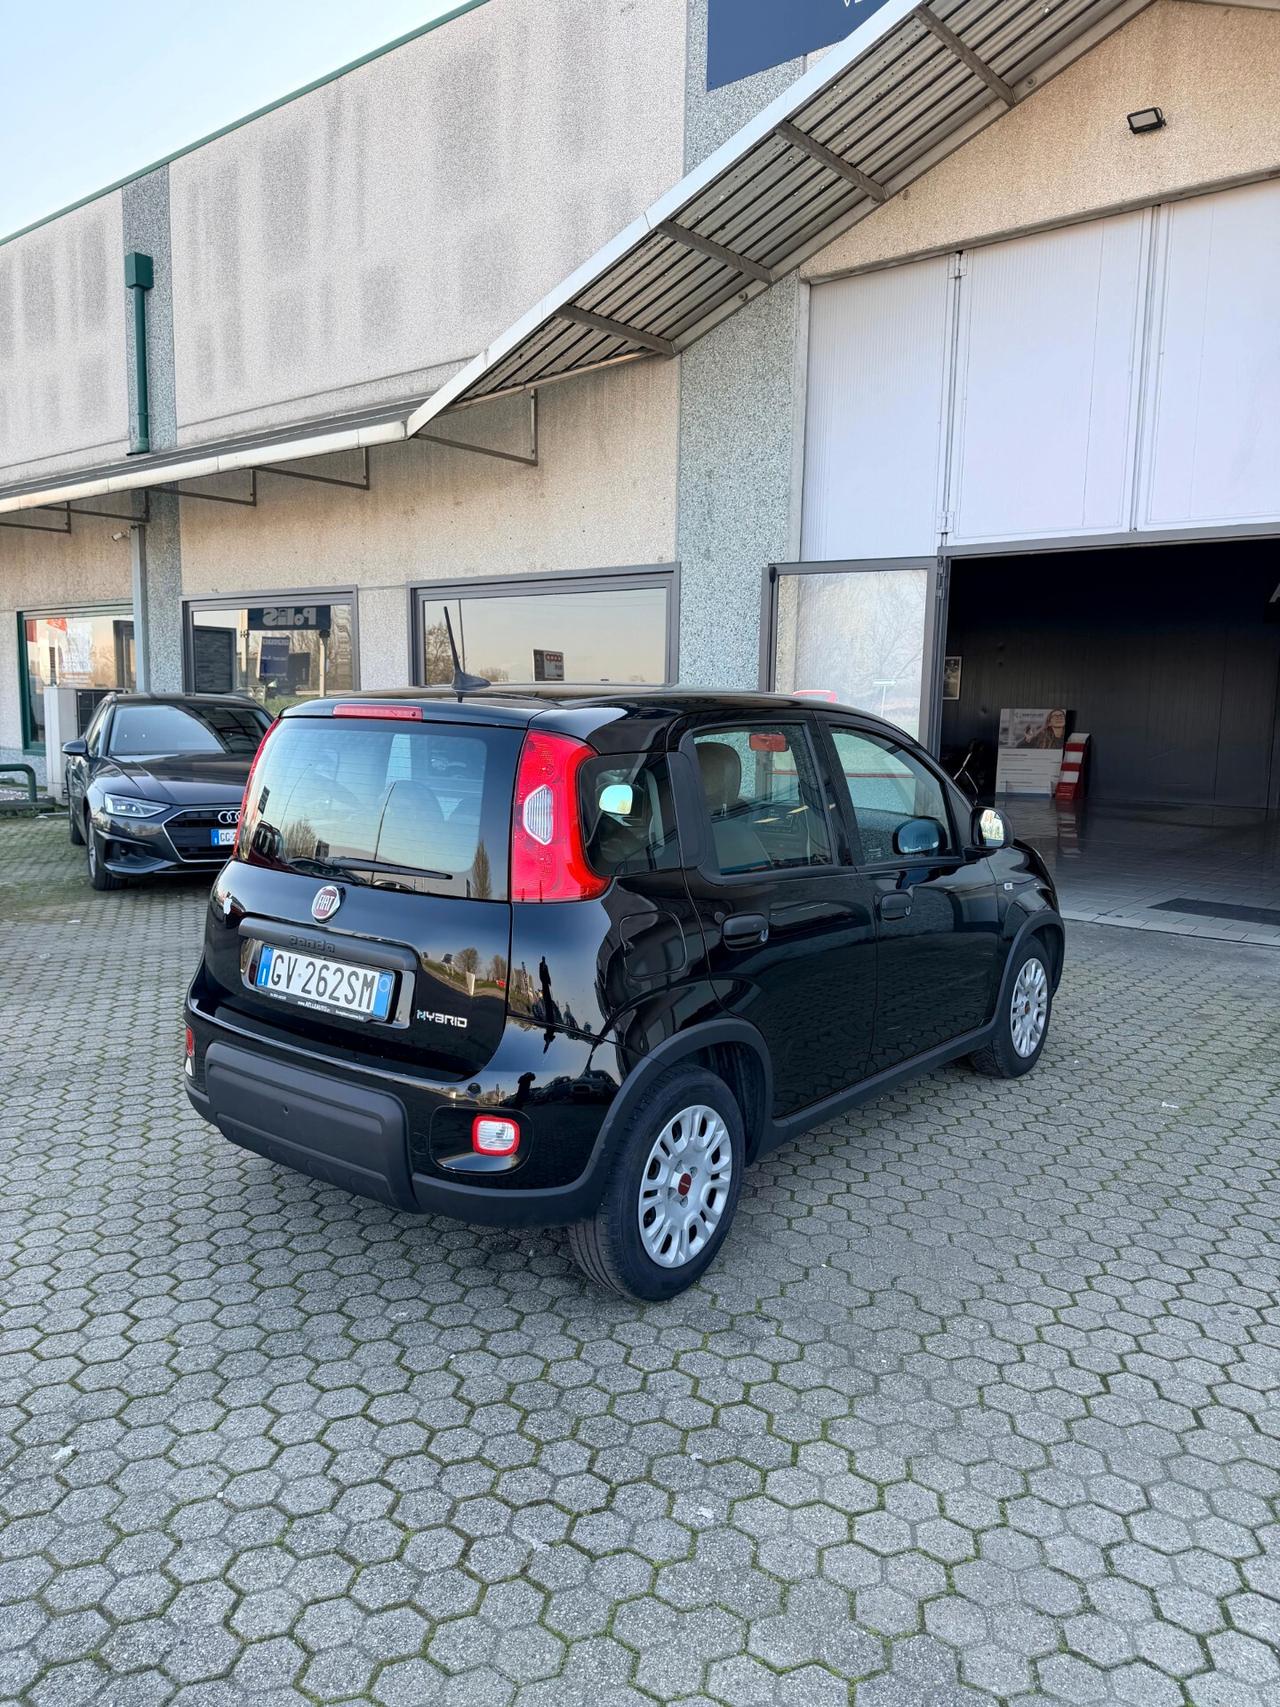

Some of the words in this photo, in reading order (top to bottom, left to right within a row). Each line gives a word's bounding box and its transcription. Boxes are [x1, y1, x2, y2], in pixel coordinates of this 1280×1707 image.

[316, 894, 336, 911] FIAT
[289, 934, 335, 953] panda
[270, 953, 299, 989] GV
[300, 960, 377, 1011] 262SM
[416, 1009, 468, 1028] HYBRID
